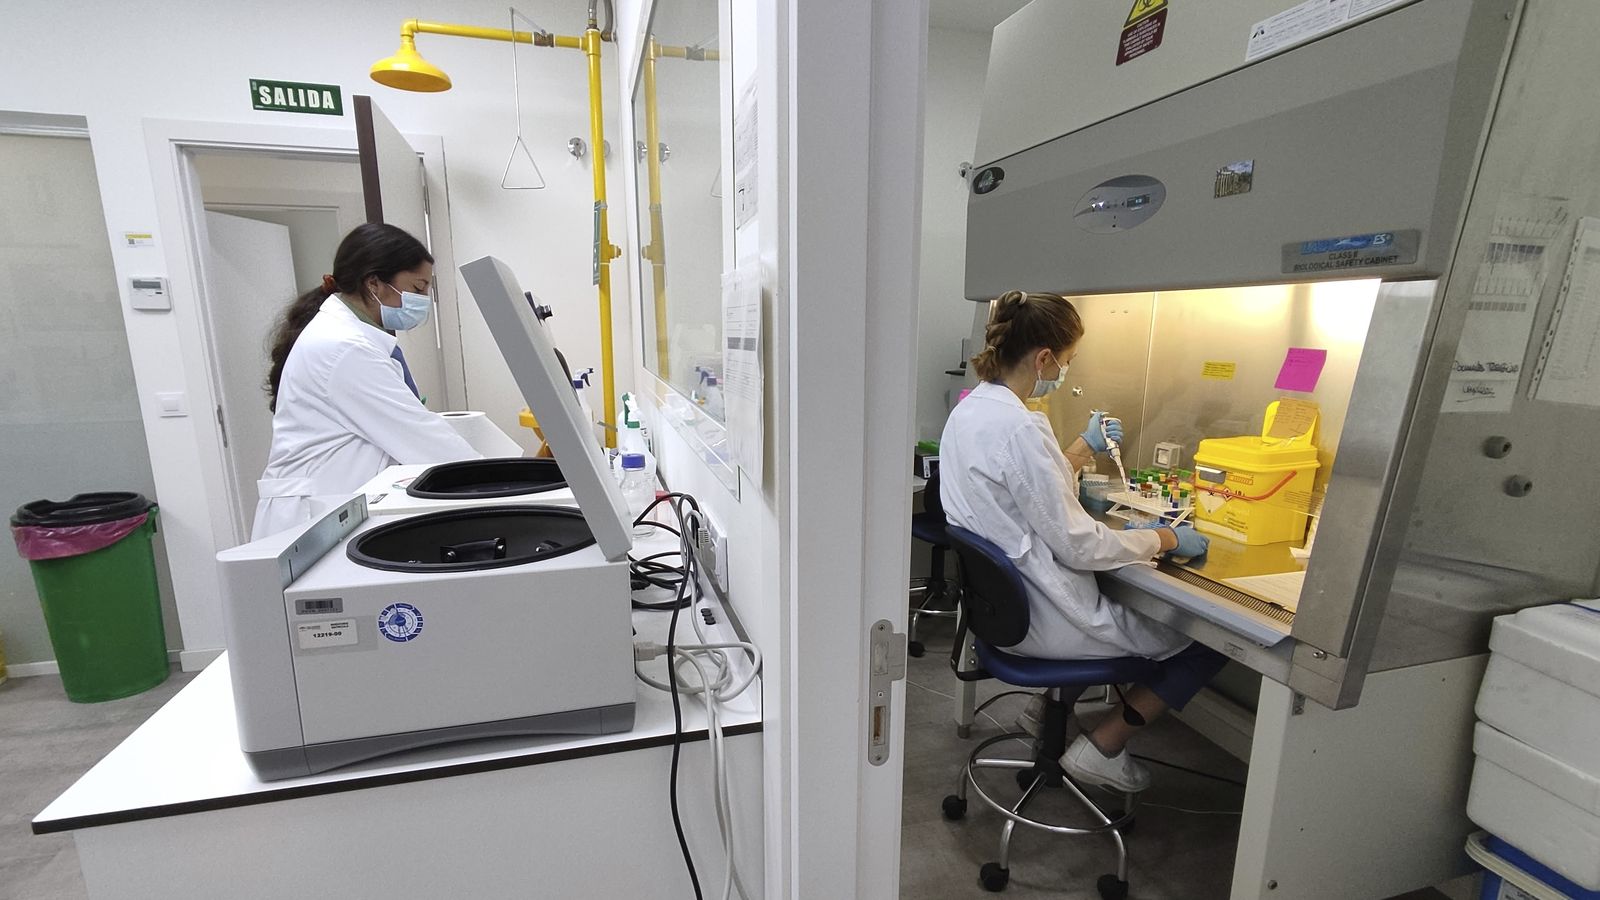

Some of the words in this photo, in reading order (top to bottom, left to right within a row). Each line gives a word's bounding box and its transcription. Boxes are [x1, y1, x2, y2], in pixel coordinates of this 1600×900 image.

[258, 85, 336, 110] SALIDA
[1293, 261, 1335, 272] BIOLOGICAL
[1336, 258, 1362, 268] SAFETY
[1364, 254, 1398, 265] CABINET
[1328, 251, 1352, 260] CLASS
